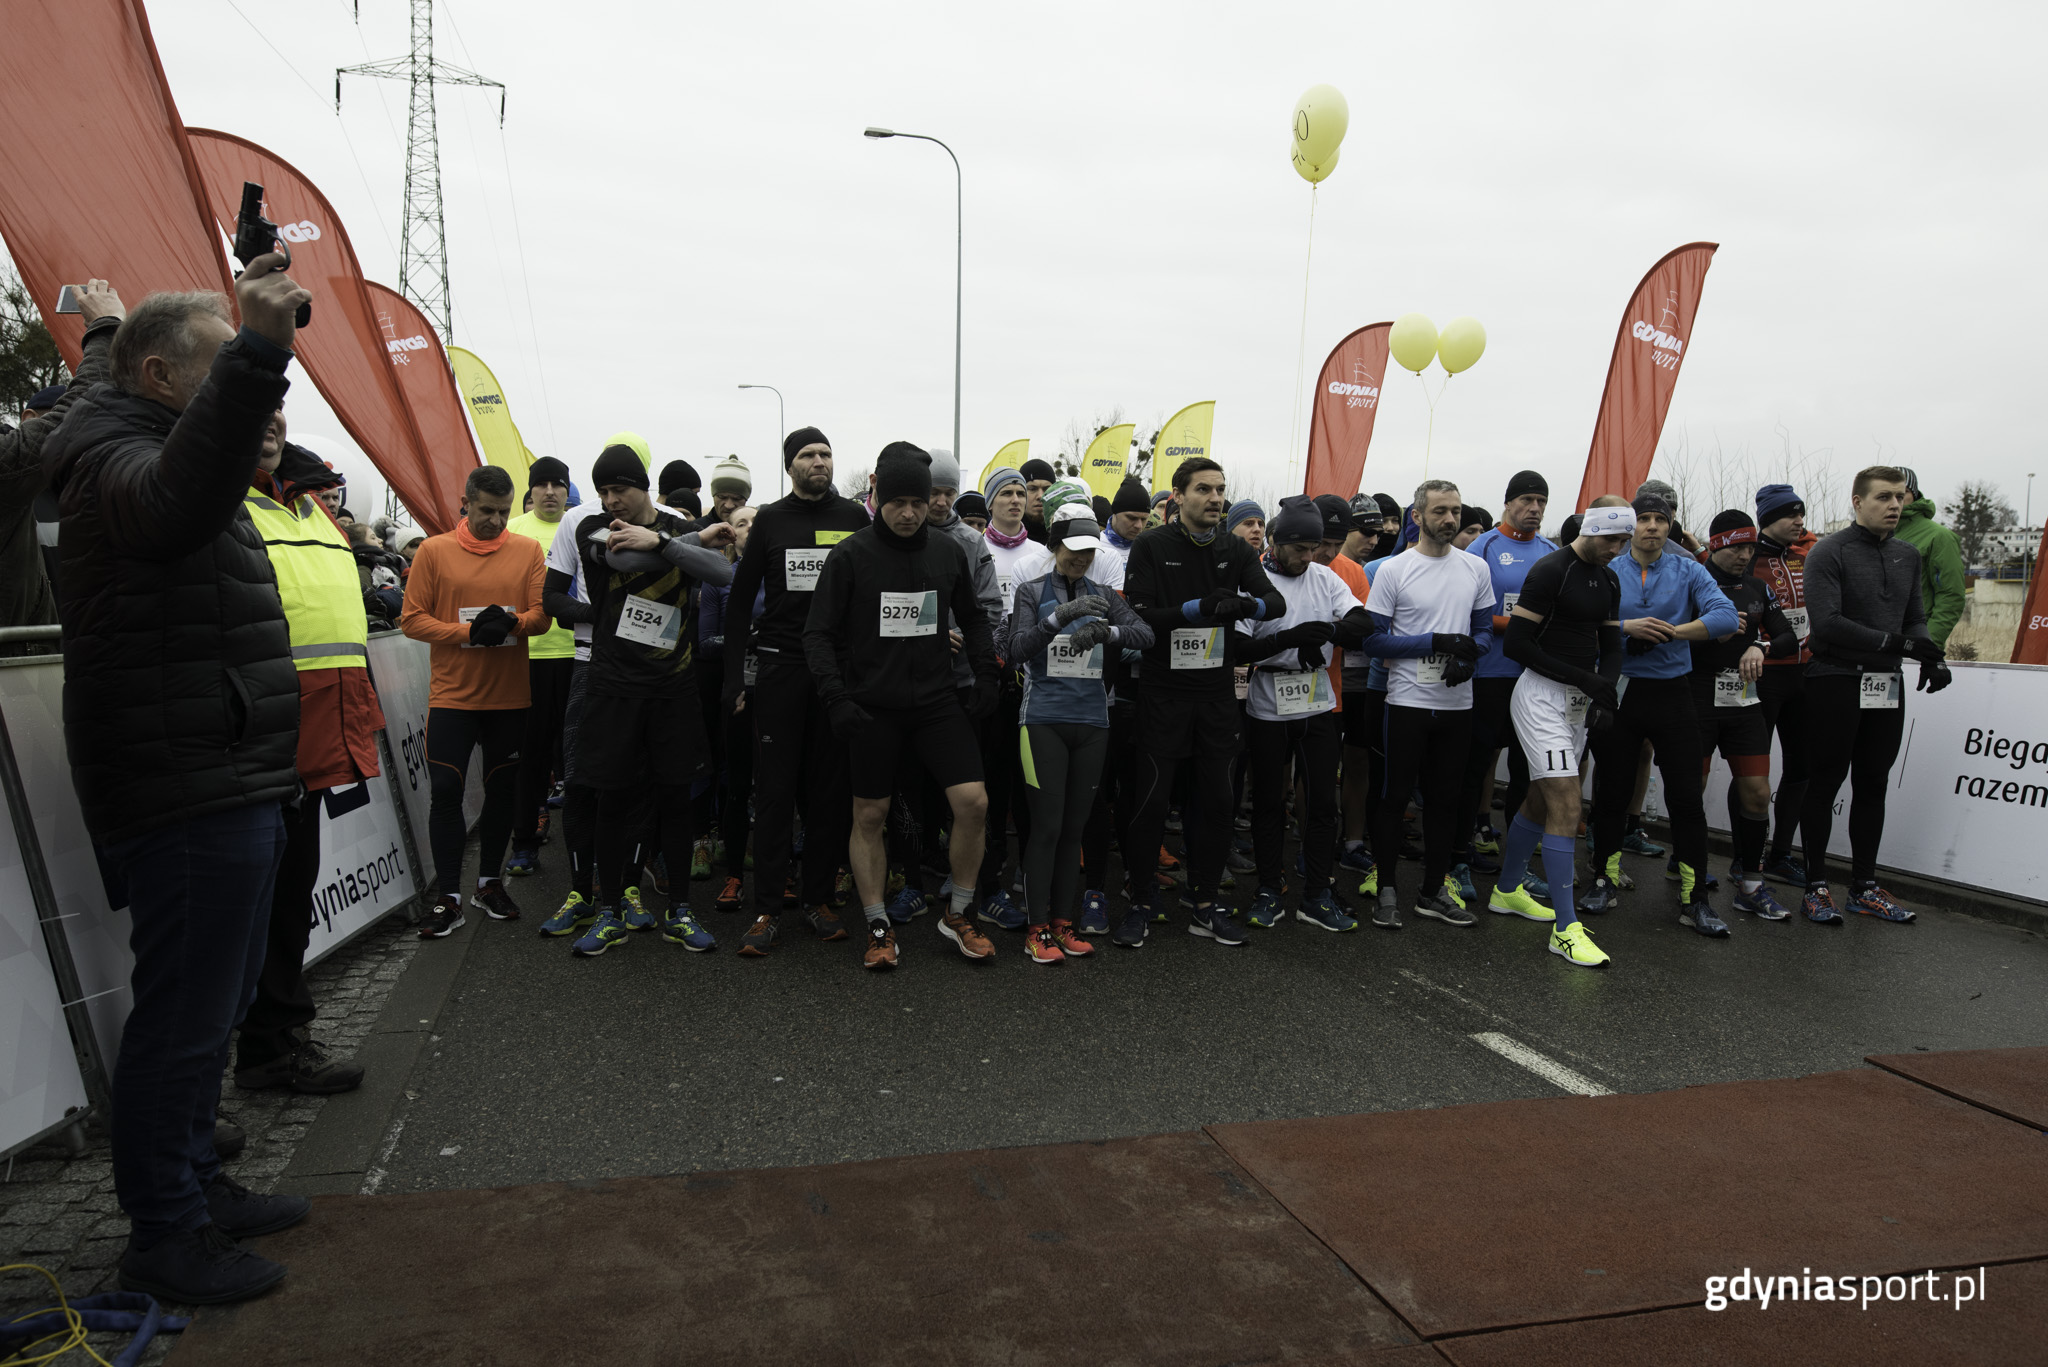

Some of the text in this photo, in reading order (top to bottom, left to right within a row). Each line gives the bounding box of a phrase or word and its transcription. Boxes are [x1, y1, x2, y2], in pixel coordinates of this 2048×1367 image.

[1633, 320, 1683, 355] GDYNIA
[1651, 349, 1680, 370] port
[1328, 381, 1379, 398] GDYNIA
[1346, 396, 1377, 409] sport
[1166, 447, 1204, 457] GDYNIA
[1092, 459, 1123, 468] GDYNIA
[788, 560, 824, 572] 3456
[625, 607, 663, 626] 1524
[882, 605, 919, 619] 9278
[1787, 615, 1806, 626] 538
[1173, 639, 1207, 650] 1861
[1277, 683, 1310, 697] 1910
[1862, 682, 1886, 692] 3145
[1964, 728, 2048, 770] Biega
[1545, 749, 1569, 771] 11
[1954, 775, 2048, 809] razem
